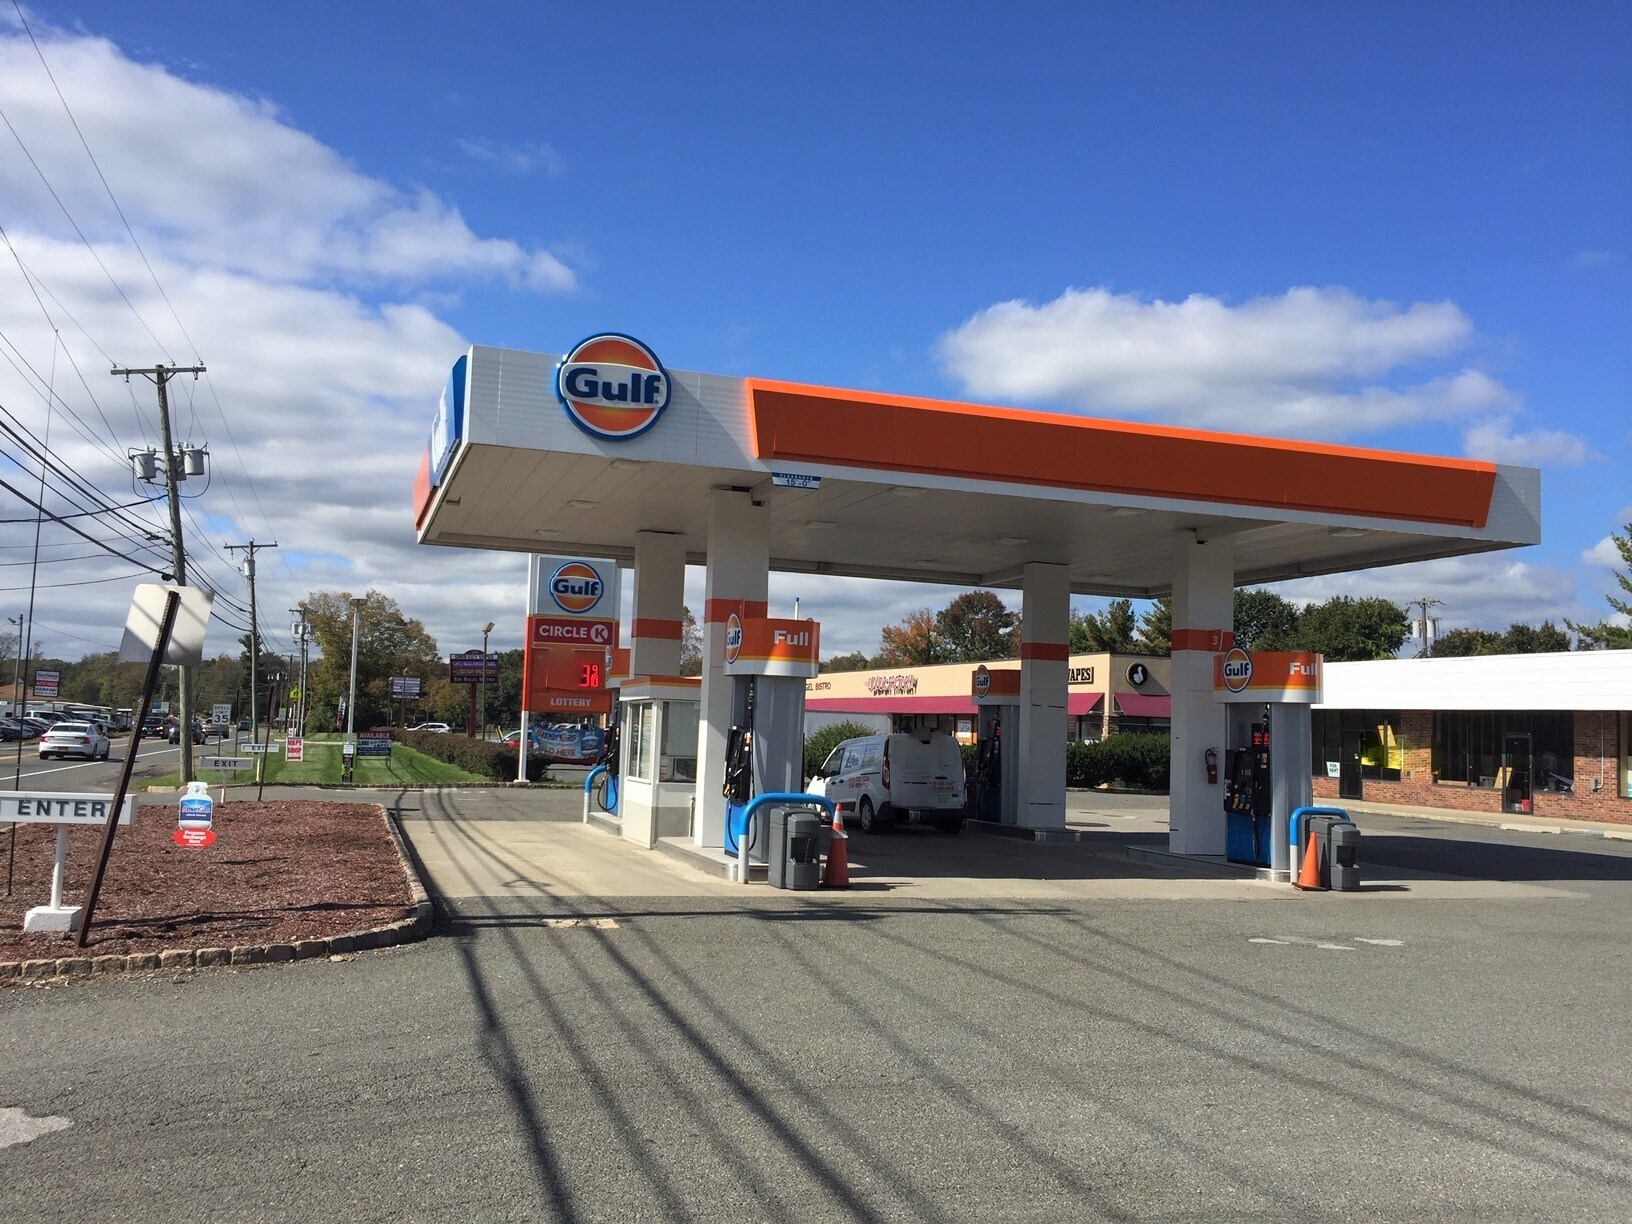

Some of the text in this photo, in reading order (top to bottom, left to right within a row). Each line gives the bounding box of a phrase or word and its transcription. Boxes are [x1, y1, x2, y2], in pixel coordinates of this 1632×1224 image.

[565, 367, 661, 404] Gulf
[553, 579, 599, 596] Gulf
[539, 625, 588, 638] CIRCLE
[774, 629, 809, 646] Full
[1212, 635, 1218, 645] 3
[1224, 662, 1250, 677] Gulf
[1289, 662, 1317, 675] Full
[815, 682, 831, 690] BISTRO
[976, 676, 989, 687] Gulf
[550, 697, 592, 706] LOTTERY
[213, 715, 229, 723] 35
[536, 728, 577, 742] AmeriGas
[214, 760, 238, 768] EXIT
[17, 799, 106, 818] ENTER
